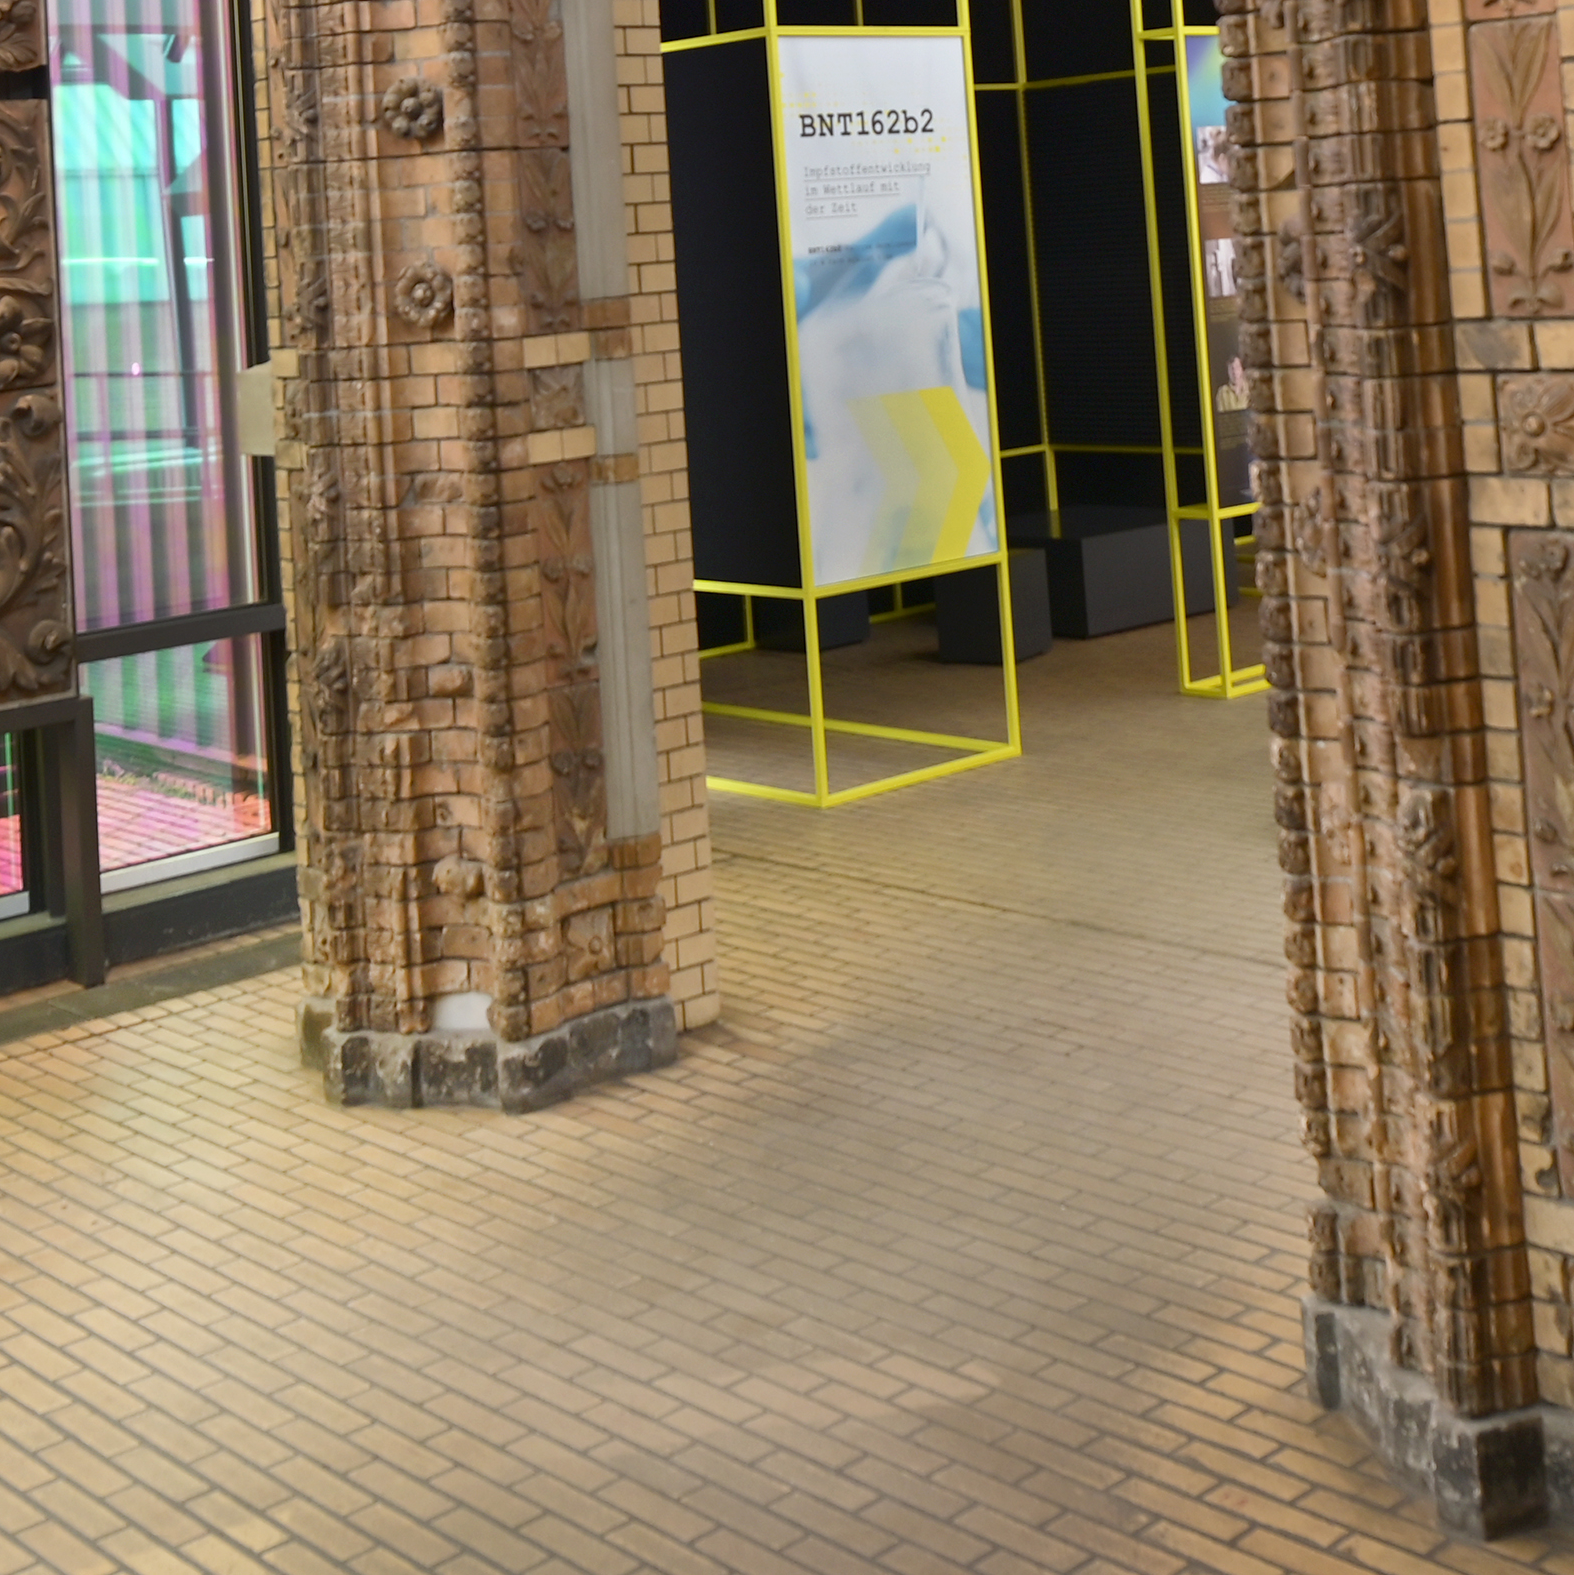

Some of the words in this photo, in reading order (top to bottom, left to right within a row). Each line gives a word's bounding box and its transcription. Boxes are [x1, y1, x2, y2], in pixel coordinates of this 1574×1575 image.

[799, 108, 934, 138] BNT162b2
[803, 161, 931, 179] Impfstoffentwicklung
[805, 185, 818, 197] im
[823, 181, 875, 195] Wettlauf
[880, 181, 900, 192] mit
[805, 203, 825, 215] der
[831, 202, 857, 214] Zeit
